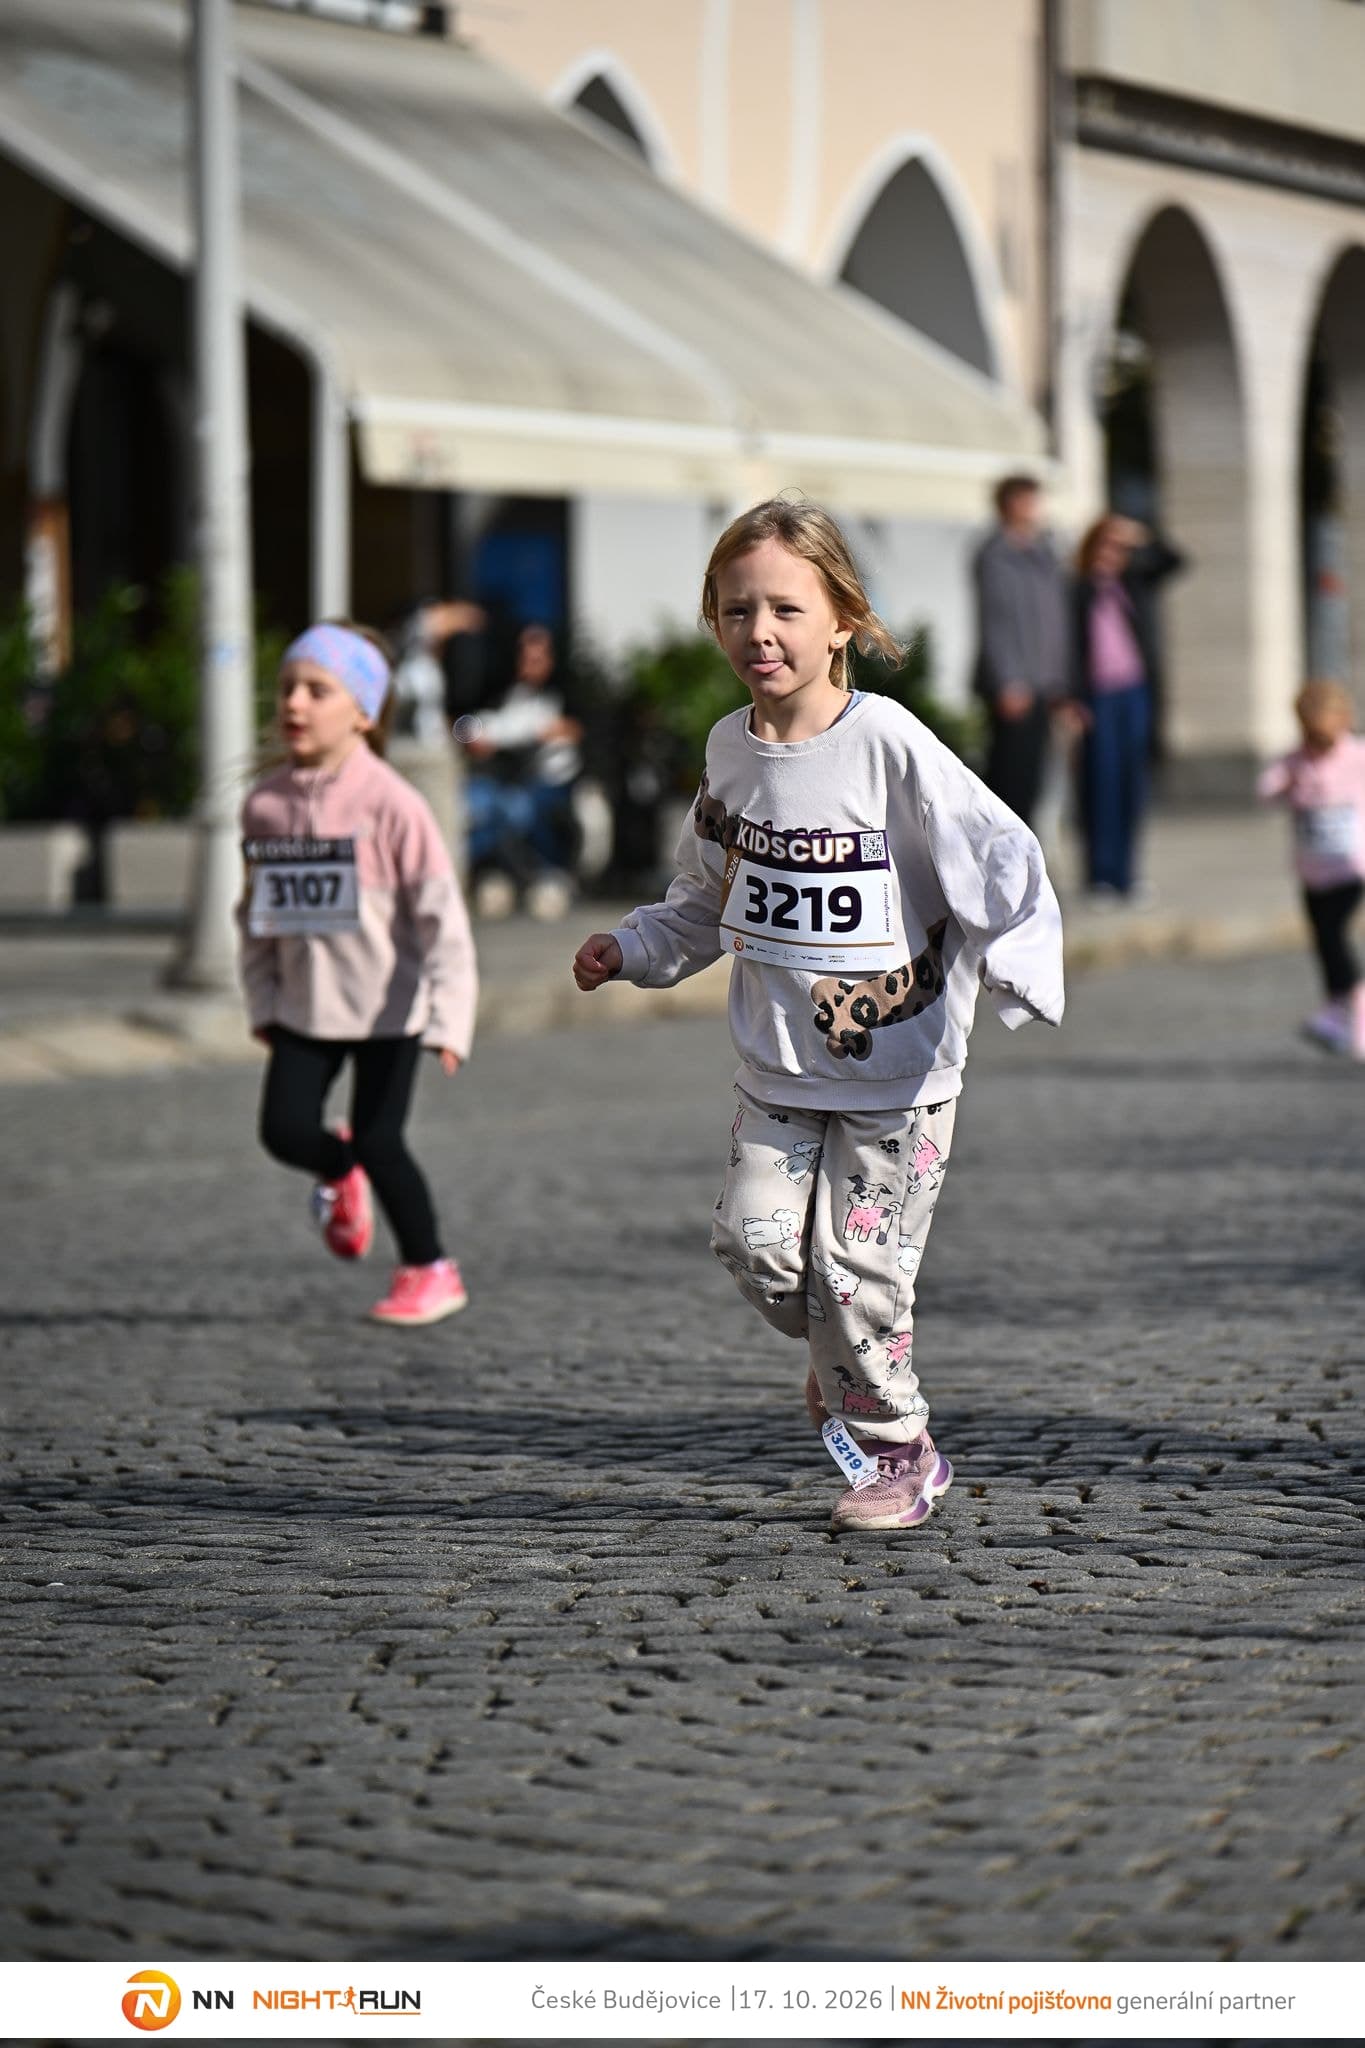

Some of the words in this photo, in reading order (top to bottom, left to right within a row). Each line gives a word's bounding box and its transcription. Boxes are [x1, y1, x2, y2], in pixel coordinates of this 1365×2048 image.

[736, 821, 855, 864] KIDSCUP
[724, 854, 739, 884] 2026
[267, 873, 341, 907] 3107
[744, 875, 862, 933] 3219
[831, 1432, 862, 1470] 3219
